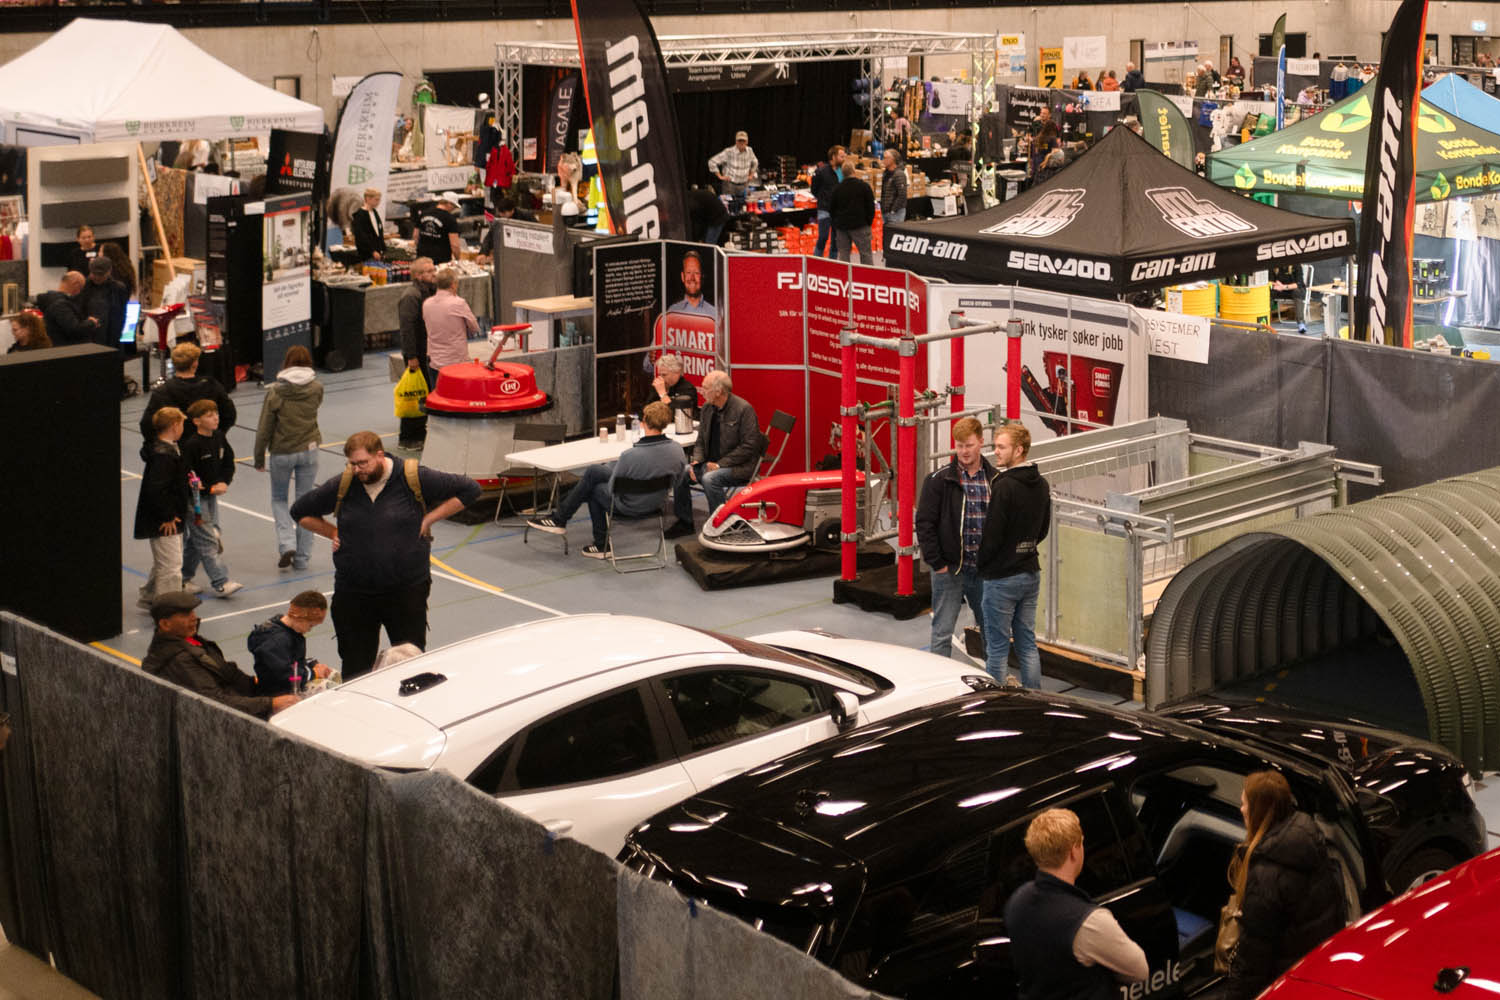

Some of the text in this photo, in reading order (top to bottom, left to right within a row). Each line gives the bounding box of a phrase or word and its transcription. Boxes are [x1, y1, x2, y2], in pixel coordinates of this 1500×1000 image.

[889, 234, 968, 261] can-am
[1130, 252, 1216, 282] can-am
[667, 327, 714, 352] SMART
[1039, 325, 1067, 343] tysker
[1072, 328, 1099, 348] søker
[1102, 331, 1124, 352] jobb
[1147, 319, 1201, 337] SYSTEMER
